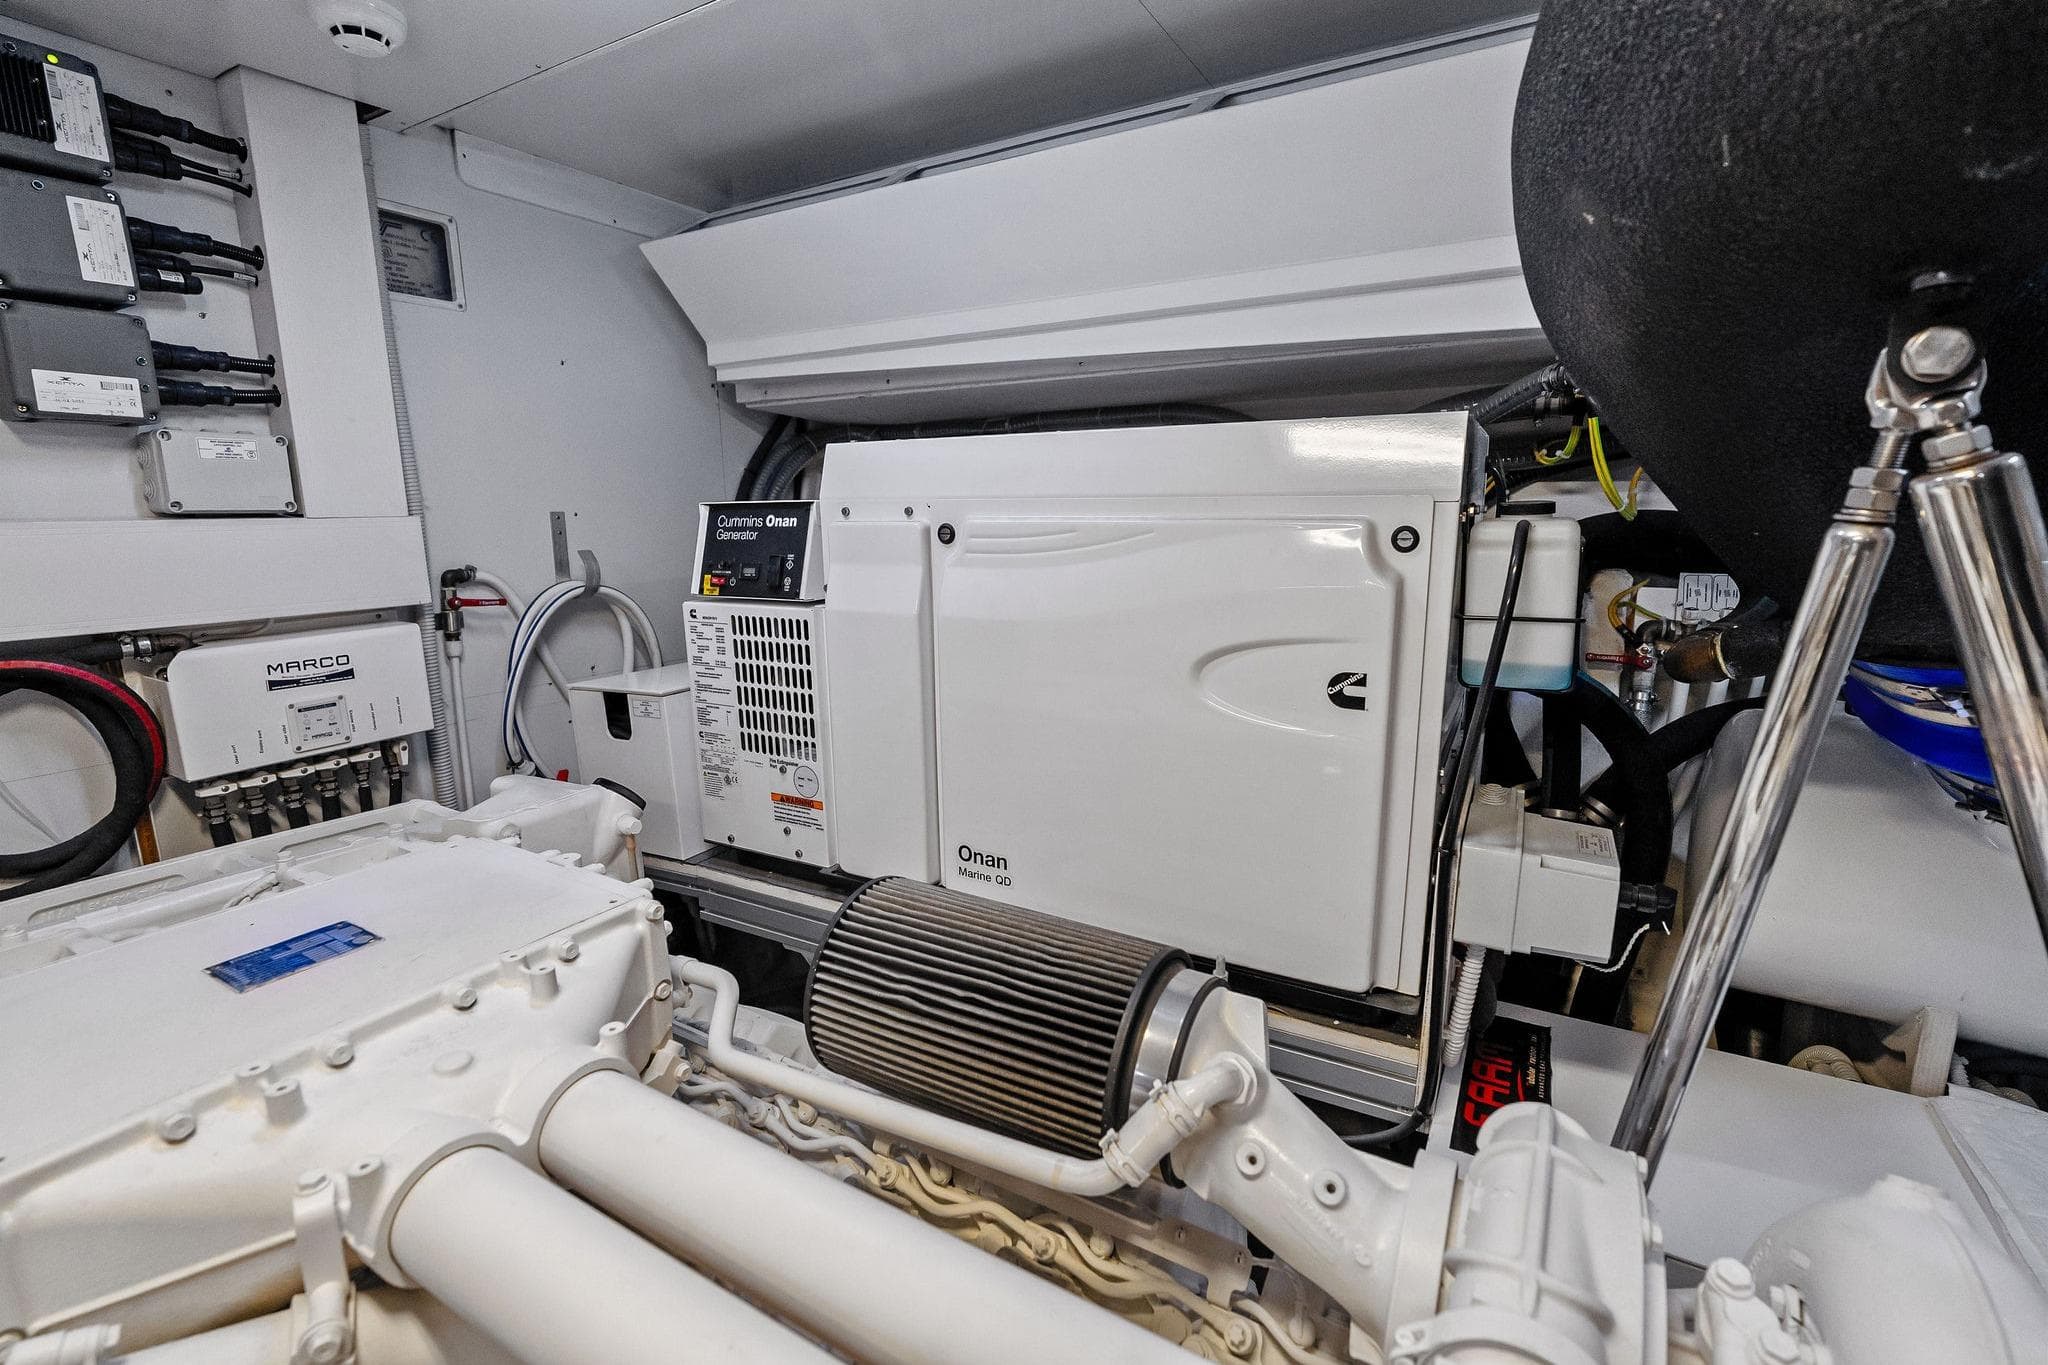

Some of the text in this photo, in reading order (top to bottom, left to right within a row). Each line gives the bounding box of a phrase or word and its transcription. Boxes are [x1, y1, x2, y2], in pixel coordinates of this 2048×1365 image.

[717, 514, 798, 528] Cummins Onan
[716, 528, 759, 540] Generator
[267, 655, 350, 676] MARCO
[1327, 673, 1365, 695] Cummins
[785, 795, 815, 809] WARNING
[958, 844, 1008, 871] Onan
[958, 866, 1012, 887] Marine QD
